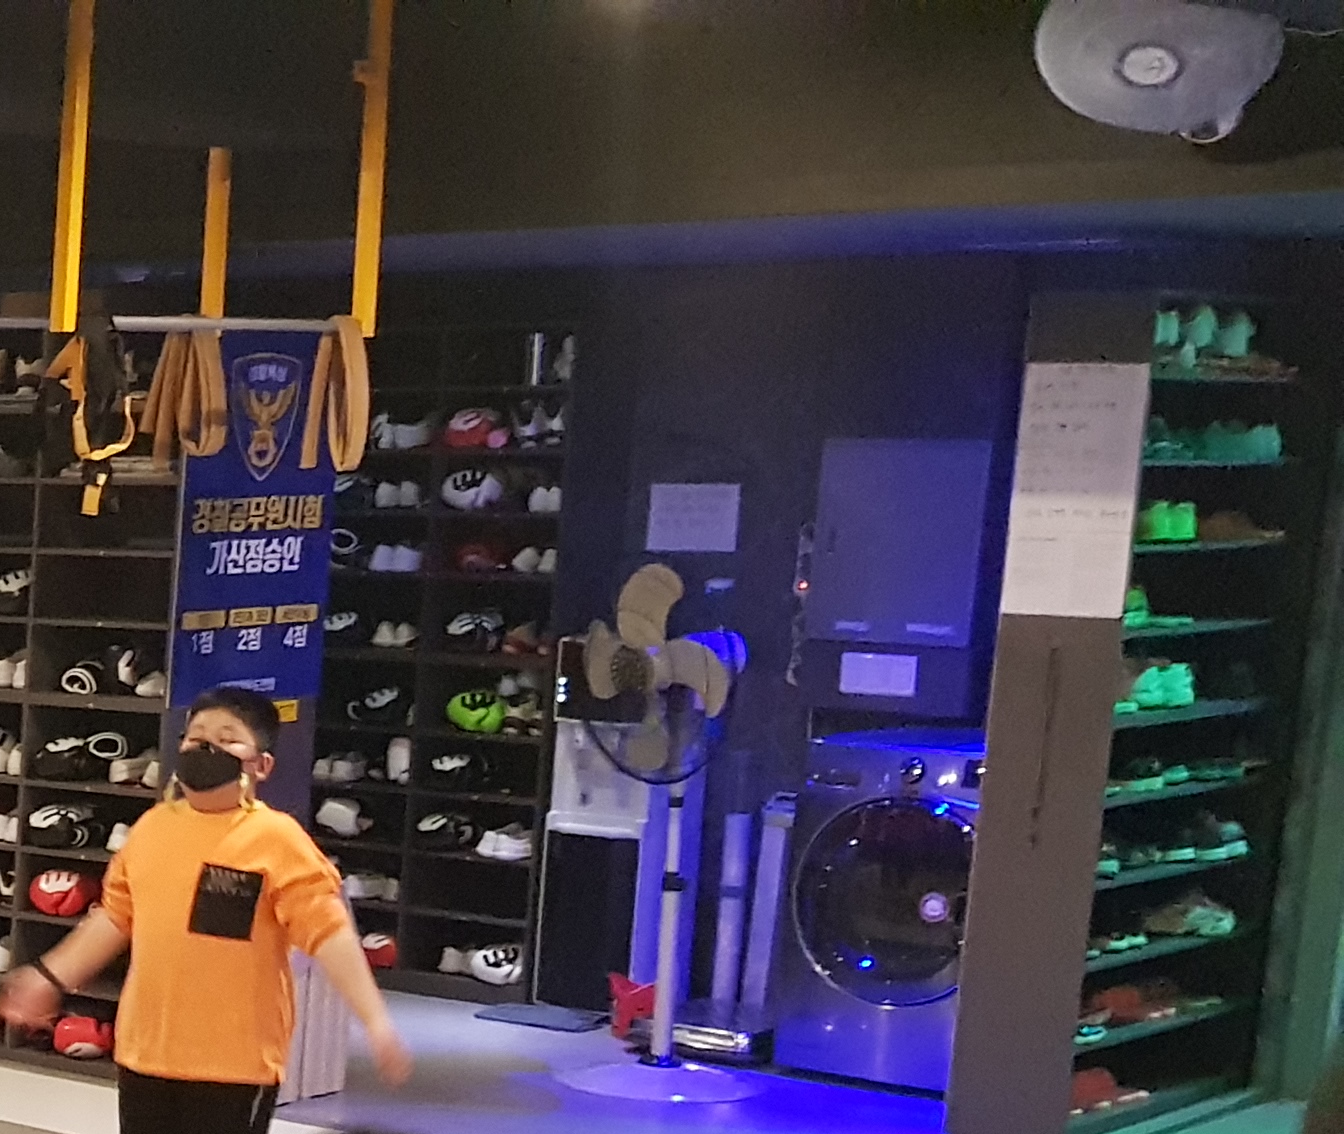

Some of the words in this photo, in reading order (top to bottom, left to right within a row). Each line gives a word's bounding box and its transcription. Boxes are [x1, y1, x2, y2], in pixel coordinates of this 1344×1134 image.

[191, 494, 326, 534] 경찰공무원시험
[205, 536, 304, 576] 가산점승인
[191, 629, 214, 655] 1점
[236, 626, 262, 652] 2점
[282, 624, 309, 649] 4점
